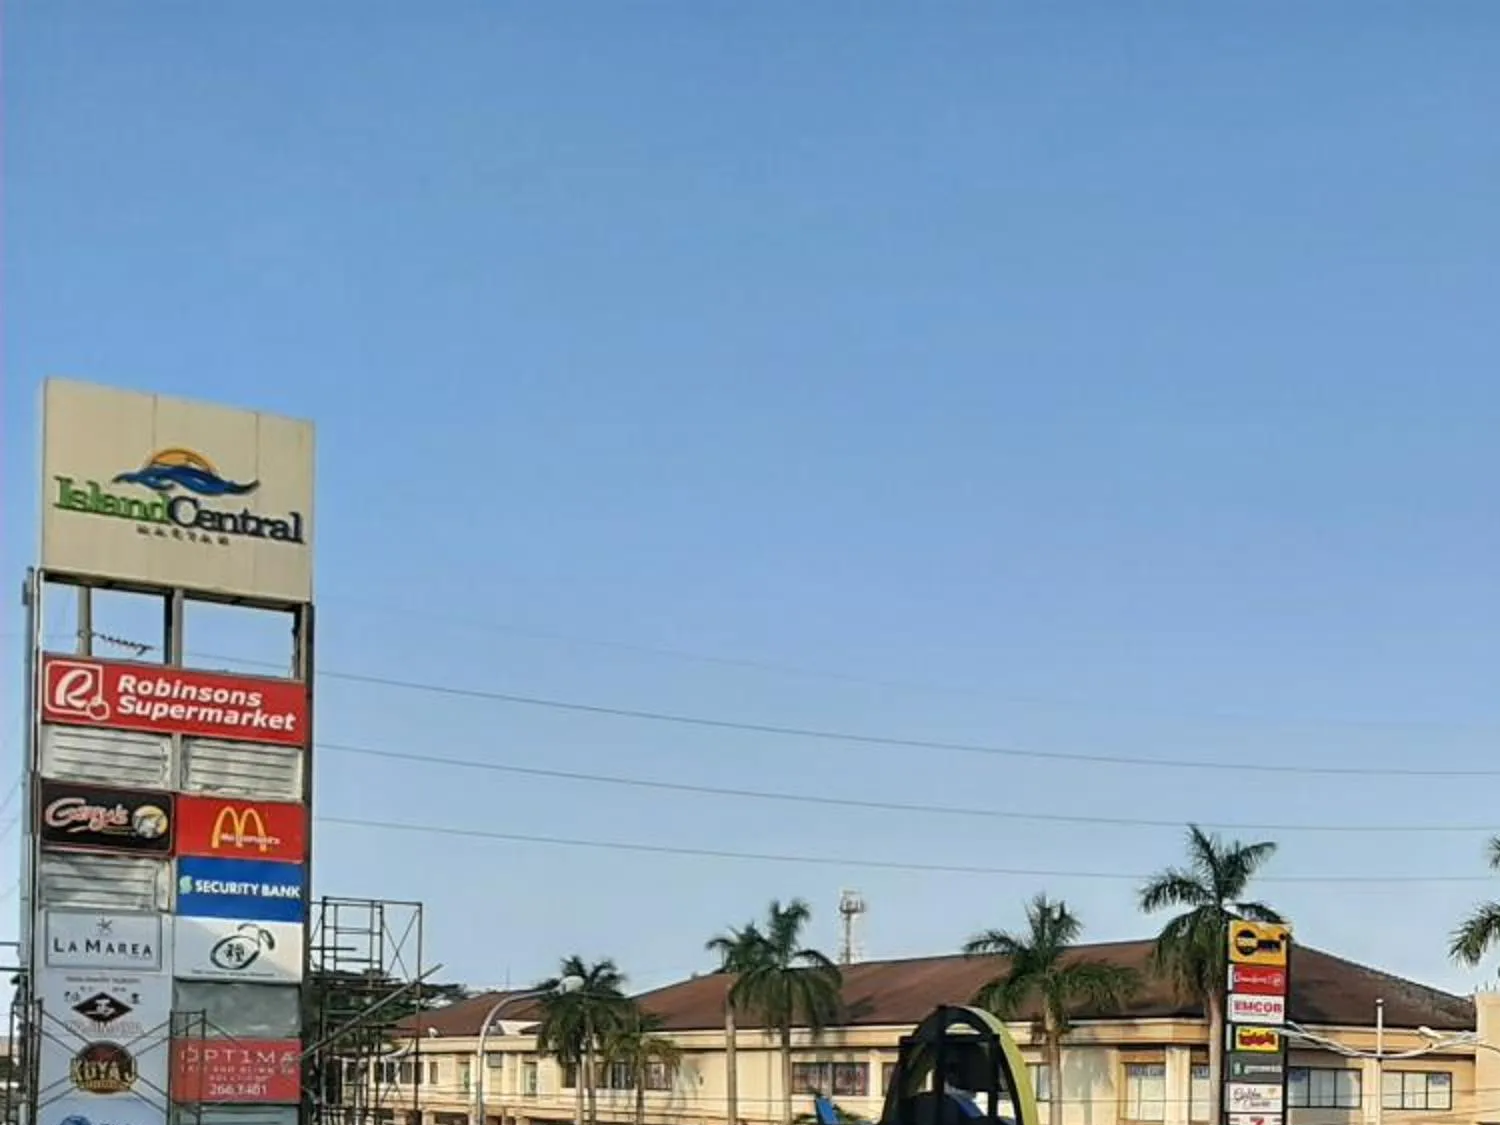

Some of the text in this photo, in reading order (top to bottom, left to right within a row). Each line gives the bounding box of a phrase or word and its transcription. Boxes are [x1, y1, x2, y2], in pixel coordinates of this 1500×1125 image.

[117, 673, 262, 708] Robinsons
[116, 698, 296, 732] Supermarket
[195, 879, 301, 899] SECURITY BANK
[84, 938, 153, 957] MAREA
[1234, 1000, 1282, 1013] EMCOR
[71, 1058, 121, 1083] KUYA
